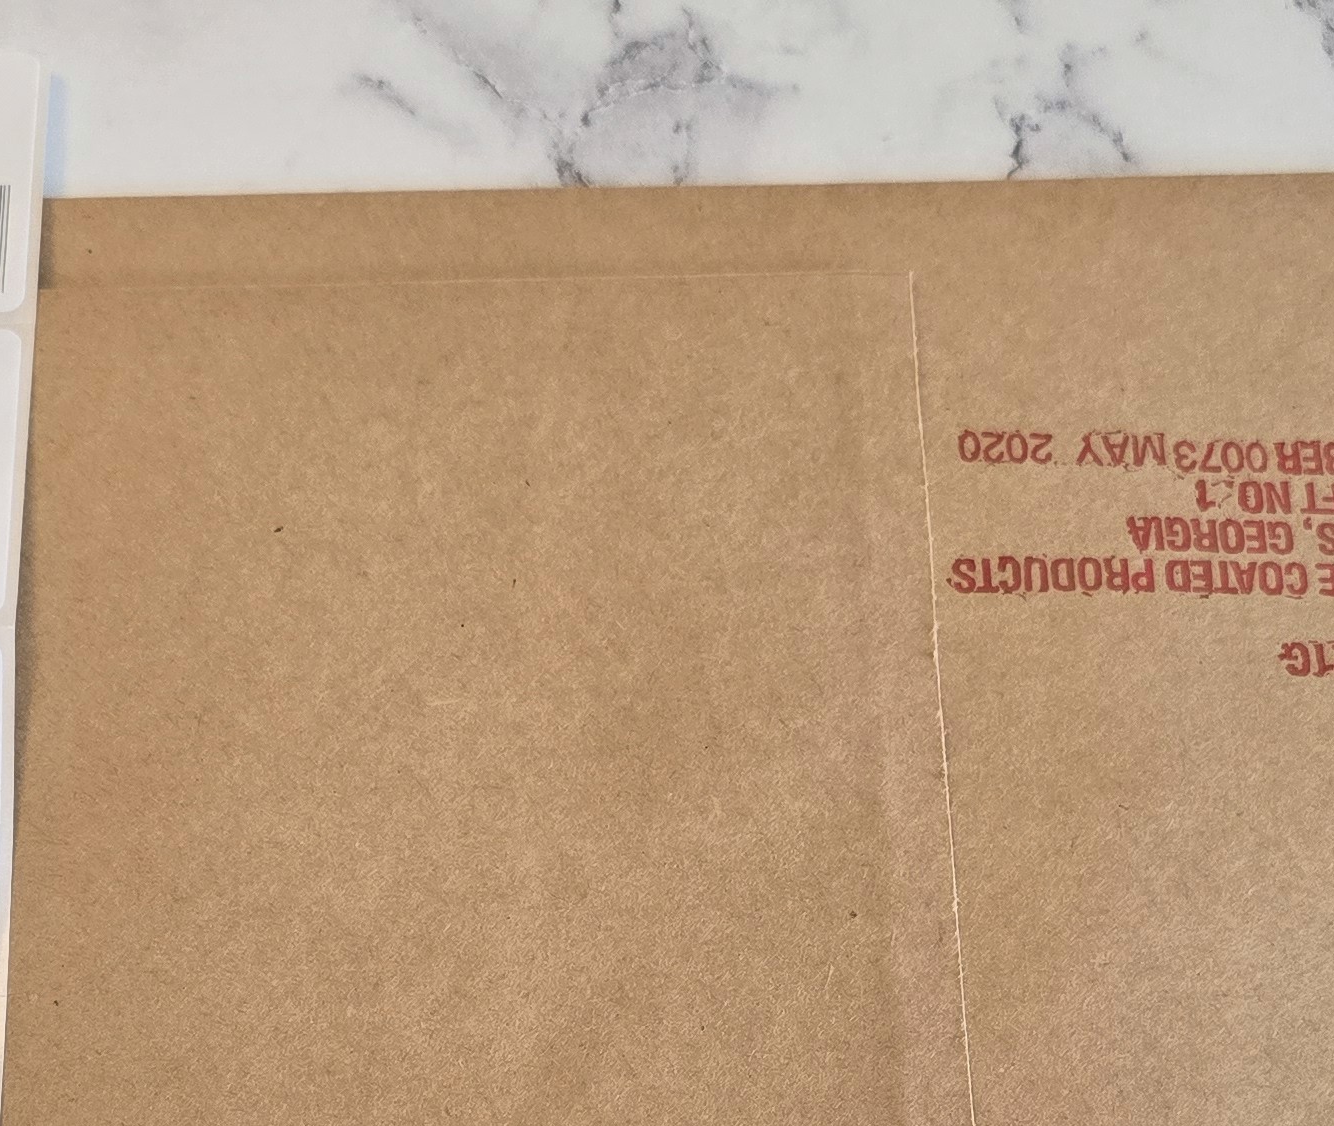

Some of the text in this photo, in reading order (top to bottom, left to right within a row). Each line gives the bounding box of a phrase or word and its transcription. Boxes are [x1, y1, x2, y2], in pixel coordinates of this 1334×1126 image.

[958, 429, 1052, 464] 2020
[1076, 432, 1167, 467] MAY
[1174, 440, 1270, 474] 0073
[1127, 516, 1294, 554] GEORGIA
[948, 556, 1155, 594] PRODUCTS
[1166, 559, 1309, 596] COATED
